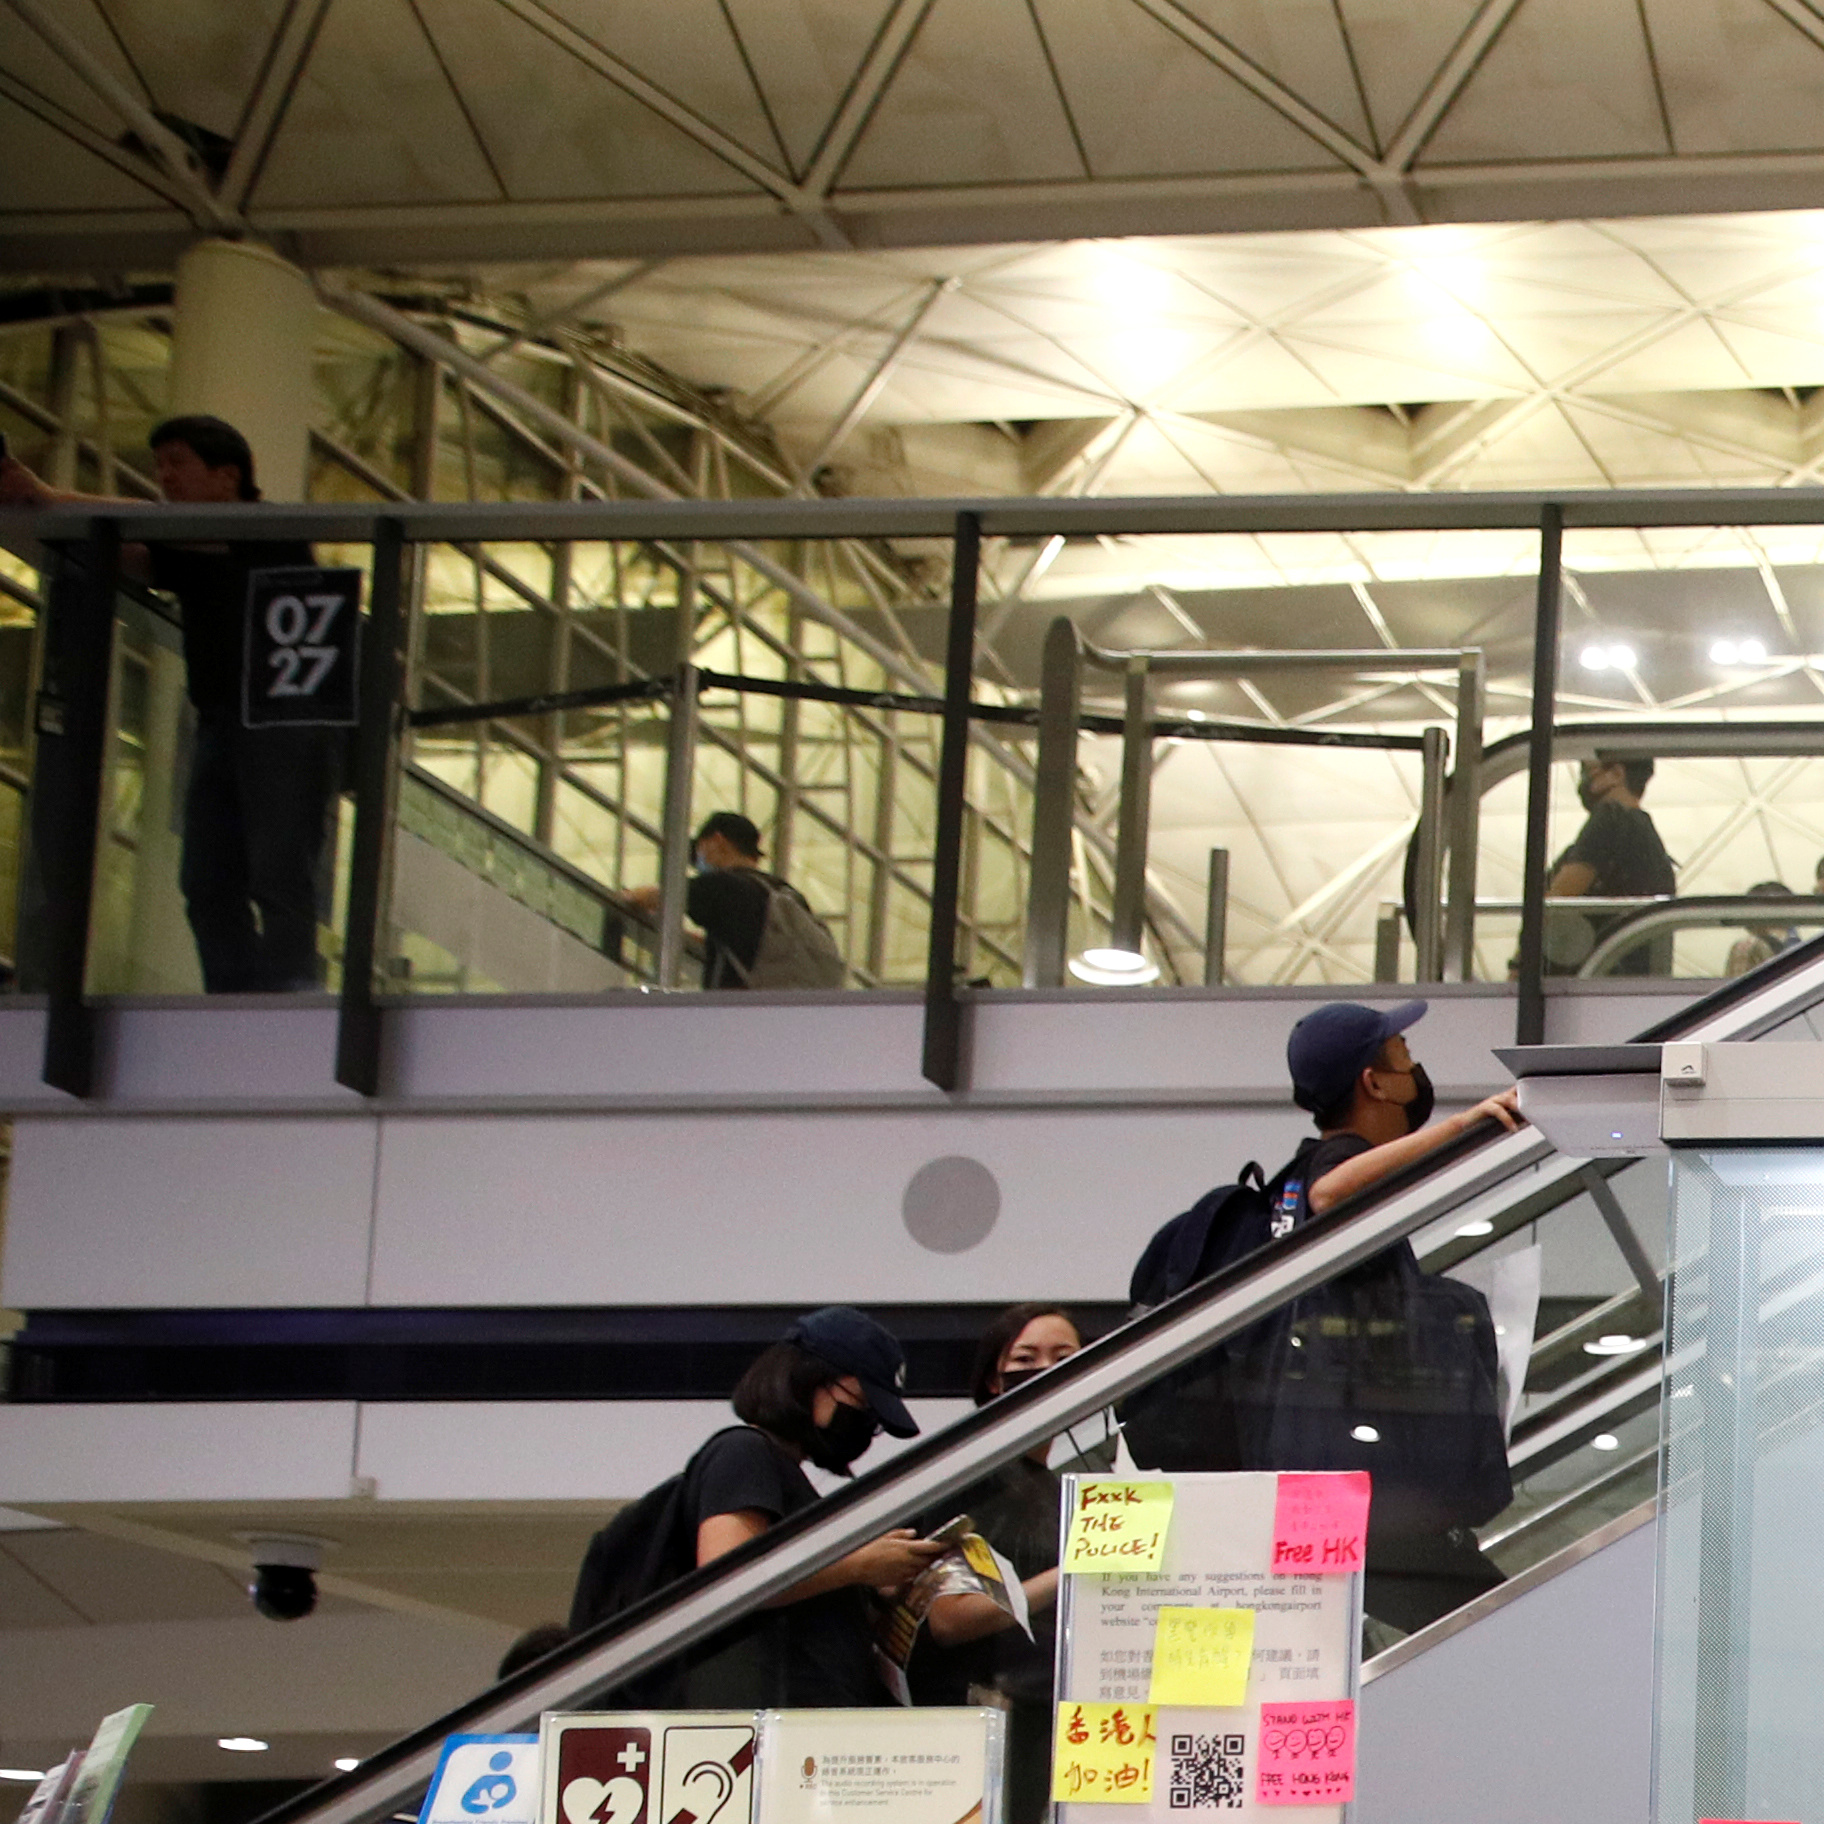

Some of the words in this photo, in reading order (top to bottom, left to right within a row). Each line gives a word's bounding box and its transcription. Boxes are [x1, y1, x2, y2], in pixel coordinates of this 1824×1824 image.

[266, 594, 347, 645] 07
[267, 646, 340, 698] 27
[1081, 1485, 1142, 1511] Fxxk
[1081, 1514, 1124, 1531] THE
[1274, 1540, 1313, 1566] Free
[1322, 1537, 1359, 1564] HK
[1102, 1587, 1130, 1598] Kong
[1136, 1586, 1200, 1596] International
[1207, 1586, 1248, 1598] Airport,
[1253, 1587, 1285, 1599] please
[1101, 1603, 1124, 1613] your
[1236, 1600, 1322, 1612] hongkongairport
[1101, 1617, 1138, 1627] website
[1067, 1705, 1157, 1747] 香港人
[1263, 1714, 1297, 1727] STAND
[1065, 1758, 1150, 1796] 加油!
[1260, 1773, 1283, 1786] FREE
